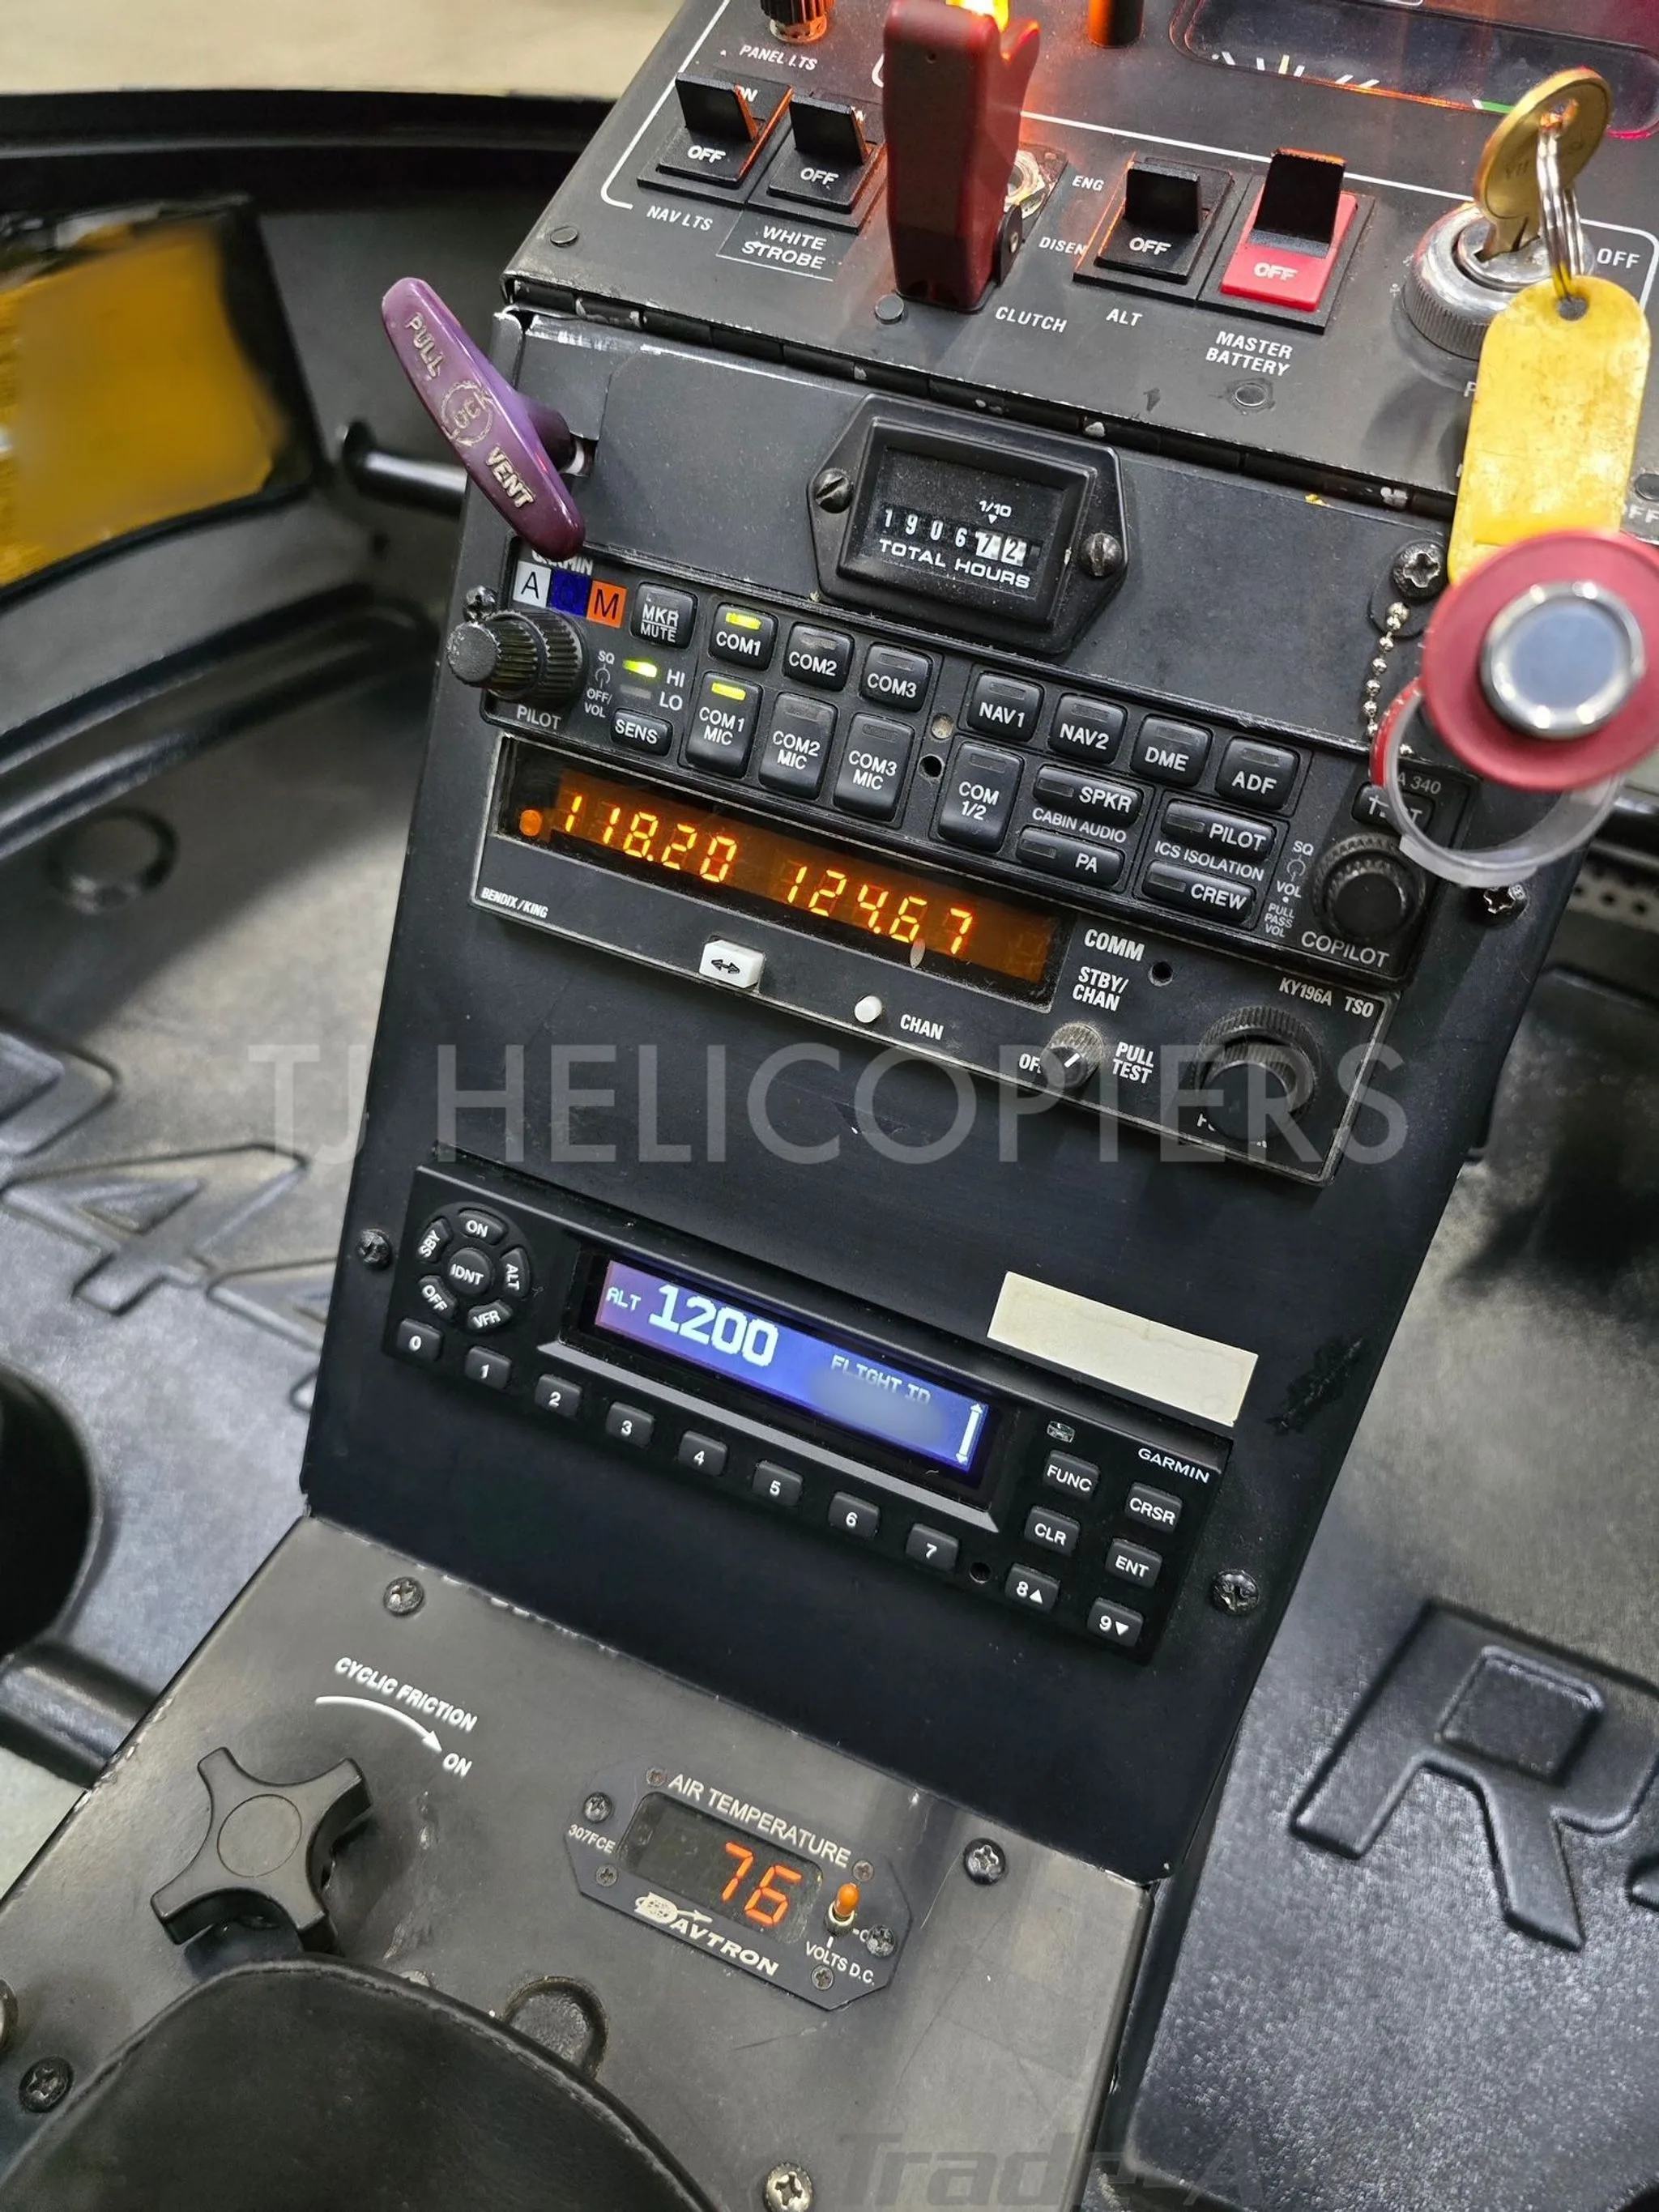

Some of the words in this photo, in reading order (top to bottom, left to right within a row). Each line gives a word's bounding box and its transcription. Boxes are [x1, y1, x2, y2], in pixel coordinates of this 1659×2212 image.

[740, 45, 786, 66] PANEL
[789, 54, 817, 71] LTS
[688, 144, 726, 165] OFF
[800, 167, 839, 185] OFF
[1072, 174, 1104, 191] ENG
[646, 204, 681, 226] NAV
[682, 212, 714, 232] LTS
[761, 224, 827, 251] WHITE
[1129, 237, 1172, 255] OFF
[741, 241, 826, 271] STROBE
[1597, 247, 1641, 269] OFF
[1254, 262, 1299, 280] OFF
[995, 306, 1068, 333] CLUTCH
[1106, 308, 1144, 326] ALT
[405, 311, 445, 379] PULL
[1216, 330, 1294, 360] MASTER
[1205, 347, 1290, 377] BATTERY
[486, 445, 535, 509] VENT
[979, 501, 1012, 518] 1/10
[1622, 503, 1659, 523] FF
[879, 538, 946, 568] TOTAL
[954, 558, 1031, 590] HOURS
[521, 571, 539, 599] A
[593, 589, 620, 620] M
[642, 606, 679, 627] MKR
[640, 624, 676, 643] MUTE
[716, 631, 761, 657] COM1
[598, 650, 615, 665] SQ
[788, 651, 838, 678] COM2
[666, 668, 685, 688] HI
[867, 673, 917, 699] COM3
[584, 701, 607, 718] VOL
[659, 691, 683, 711] LO
[516, 705, 561, 730] PILOT
[979, 701, 1026, 728] NAV1
[615, 719, 659, 745] SENS
[703, 725, 733, 746] MIC
[772, 731, 821, 757] COM2
[1060, 723, 1110, 750] NAV2
[777, 749, 808, 770] MIC
[849, 750, 897, 777] COM3
[1144, 746, 1189, 772] DME
[853, 769, 884, 791] MIC
[1231, 770, 1277, 795] ADF
[1410, 775, 1441, 795] 340
[958, 781, 1000, 806] COM
[1079, 786, 1132, 813] SPKR
[961, 800, 987, 821] 1/2
[1369, 795, 1422, 823] TT
[1032, 807, 1077, 830] CABIN
[1079, 820, 1127, 844] AUDIO
[1209, 822, 1267, 851] PILOT
[1154, 840, 1181, 859] ICS
[1183, 848, 1265, 882] ISOLATION
[1293, 840, 1314, 856] SQ
[1075, 853, 1098, 873] PA
[1191, 883, 1247, 911] CREW
[1276, 880, 1303, 898] VOL
[1264, 912, 1293, 929] PASS
[1268, 902, 1295, 918] PULL
[1265, 923, 1286, 938] VOL
[1084, 928, 1145, 961] COMM
[1301, 931, 1389, 969] COPILOT
[1078, 965, 1129, 994] STBY/
[1073, 984, 1120, 1012] CHAN
[1279, 977, 1333, 1007] KY196A
[1344, 995, 1374, 1018] TSO
[900, 1013, 944, 1041] CHAN
[1019, 1053, 1041, 1073] OF
[1115, 1041, 1154, 1068] PULL
[1112, 1058, 1153, 1085] TEST
[465, 1219, 489, 1238] ON
[417, 1230, 441, 1259] SBY
[450, 1264, 484, 1286] IDNT
[505, 1263, 520, 1291] ALT
[421, 1285, 448, 1311] OFF
[605, 1286, 642, 1312] ALT
[473, 1310, 501, 1328] VFR
[647, 1284, 779, 1367] 1200
[409, 1336, 422, 1352] 0
[480, 1364, 489, 1379] 1
[831, 1353, 902, 1396] FLIGHT
[904, 1383, 931, 1405] ID
[548, 1391, 561, 1408] 2
[621, 1419, 633, 1436] 3
[693, 1450, 706, 1466] 4
[1137, 1447, 1210, 1484] GARMIN
[769, 1480, 781, 1496] 5
[1047, 1464, 1092, 1493] FUNC
[846, 1511, 858, 1528] 6
[1129, 1497, 1175, 1526] CRSR
[1034, 1523, 1067, 1546] CLR
[925, 1543, 937, 1559] 7
[1115, 1554, 1149, 1578] ENT
[1016, 1580, 1028, 1597] 8
[1099, 1615, 1112, 1631] 9
[335, 1656, 398, 1696] CYCLIC
[395, 1684, 478, 1734] FRICTION
[442, 1752, 473, 1779] ON
[667, 1773, 704, 1801] AIR
[707, 1787, 852, 1869] TEMPERATURE
[721, 1840, 803, 1928] 76
[805, 1941, 847, 1973] VOLTS
